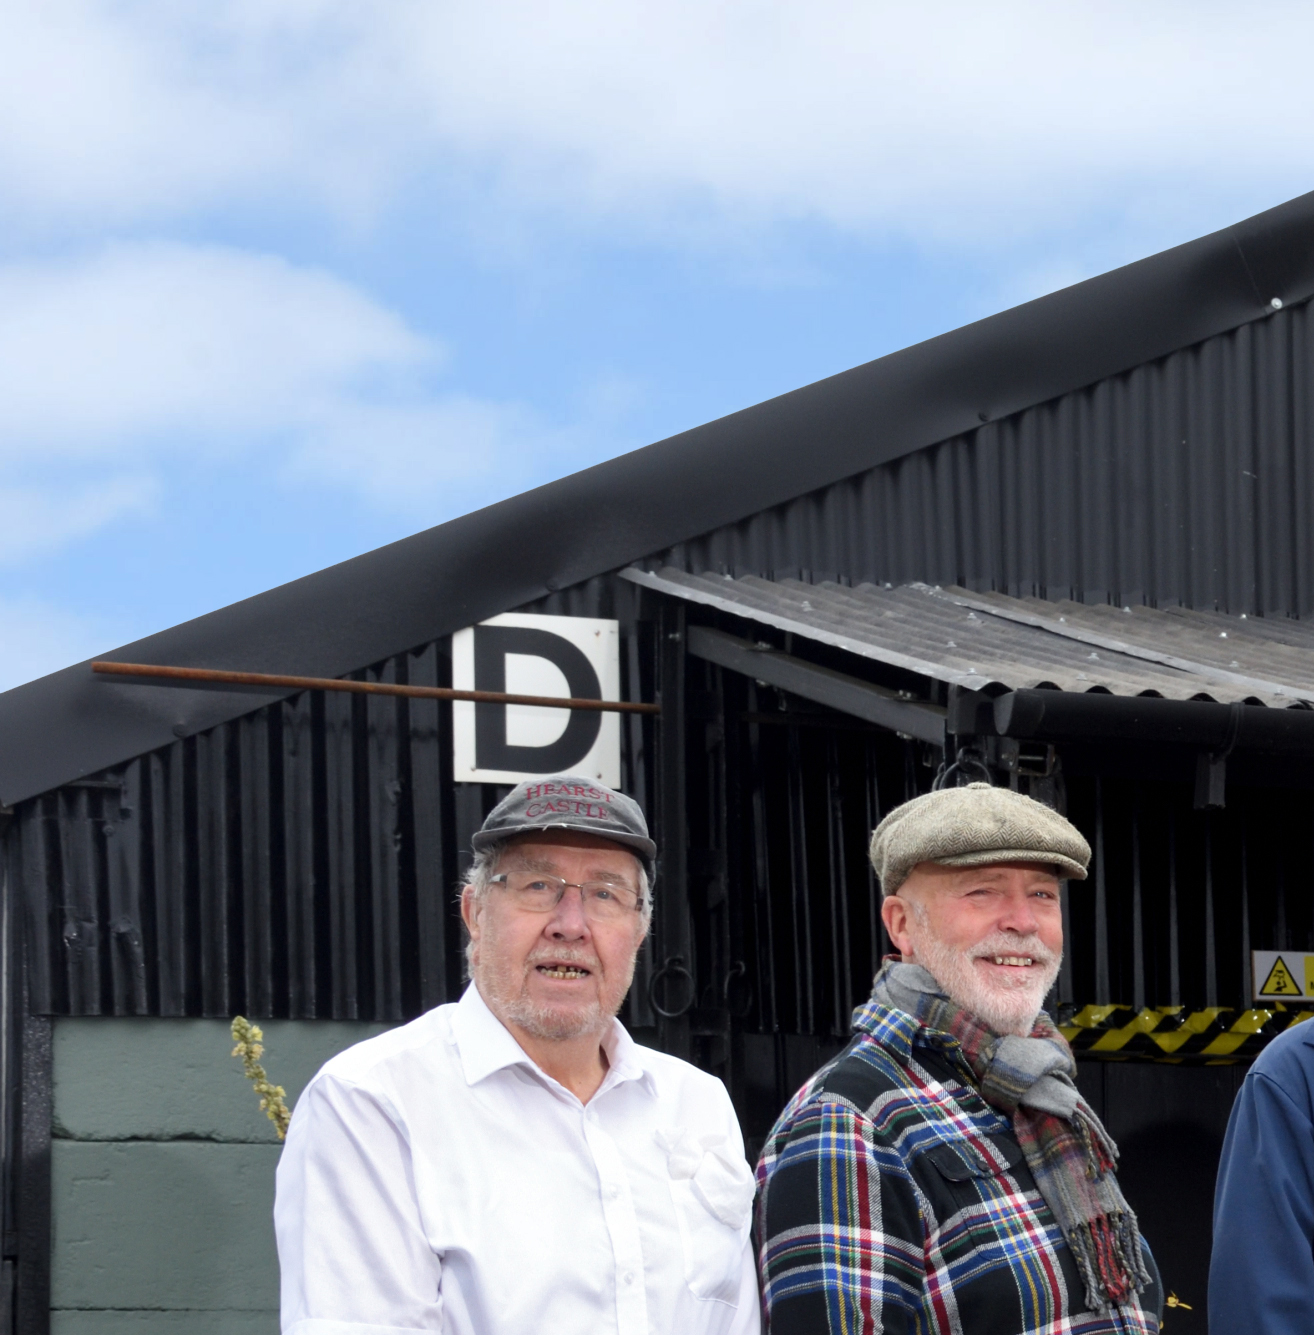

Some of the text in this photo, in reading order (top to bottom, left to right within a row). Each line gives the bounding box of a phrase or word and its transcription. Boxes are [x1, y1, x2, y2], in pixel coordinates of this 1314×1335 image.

[473, 624, 603, 774] D
[526, 784, 614, 803] HEARST
[526, 801, 609, 820] CASTLE
